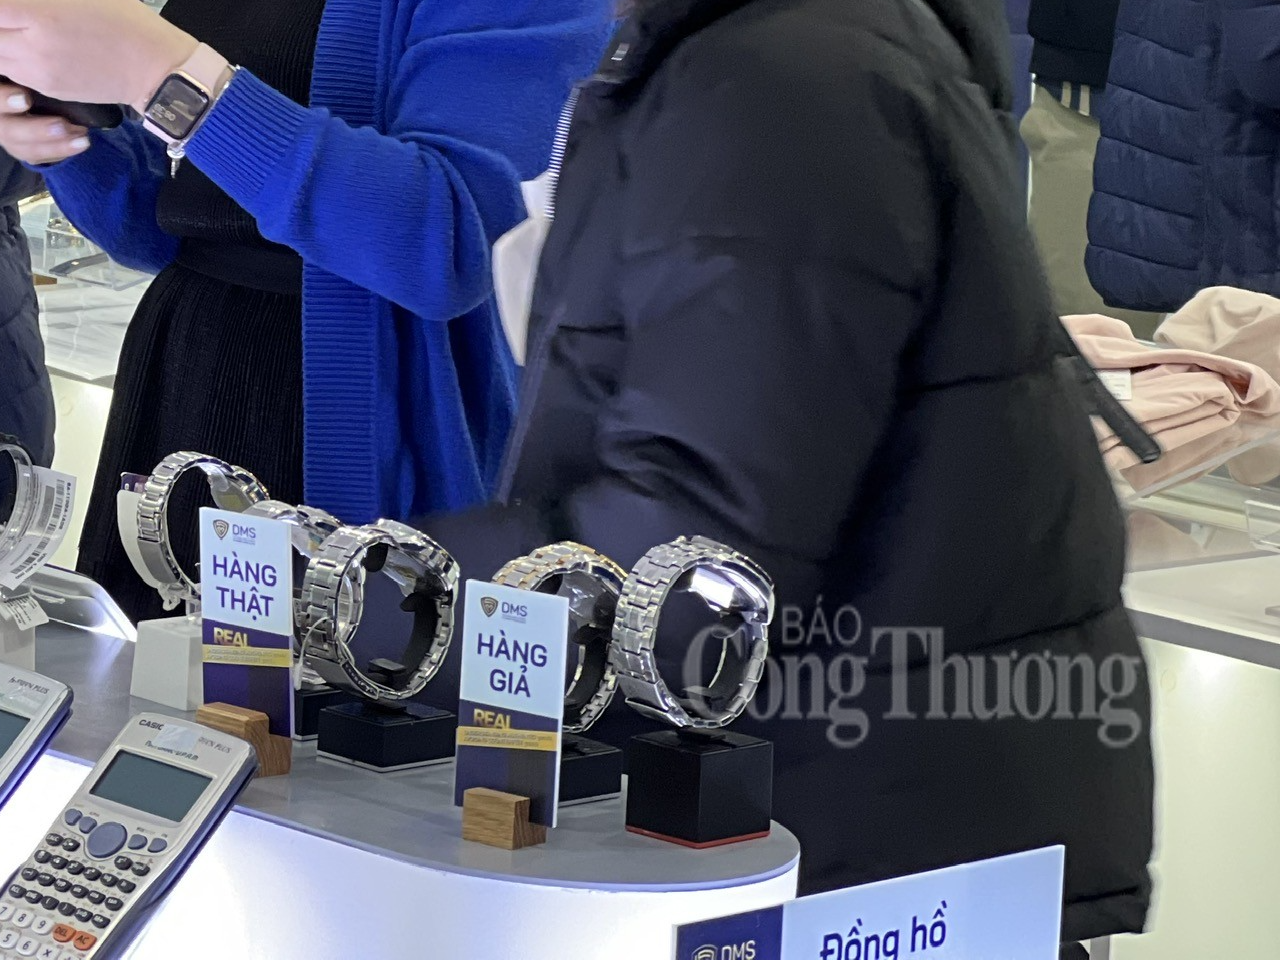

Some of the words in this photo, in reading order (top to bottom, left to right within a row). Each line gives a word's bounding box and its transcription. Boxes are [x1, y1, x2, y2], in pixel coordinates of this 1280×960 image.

[232, 523, 256, 539] DMS
[212, 554, 278, 587] HÀNG
[216, 585, 274, 620] THẬT
[502, 600, 528, 618] DMS
[477, 630, 548, 667] HÀNG
[32, 684, 50, 695] PLUS
[489, 664, 532, 698] GIẢ
[0, 907, 8, 916] 7
[18, 914, 26, 922] 8
[38, 920, 46, 929] 9
[56, 926, 68, 937] DEL
[76, 936, 88, 944] AC
[4, 934, 12, 943] 5
[22, 940, 30, 950] 6
[820, 918, 900, 960] Đồng
[910, 900, 947, 953] hồ
[720, 940, 756, 960] DMS
